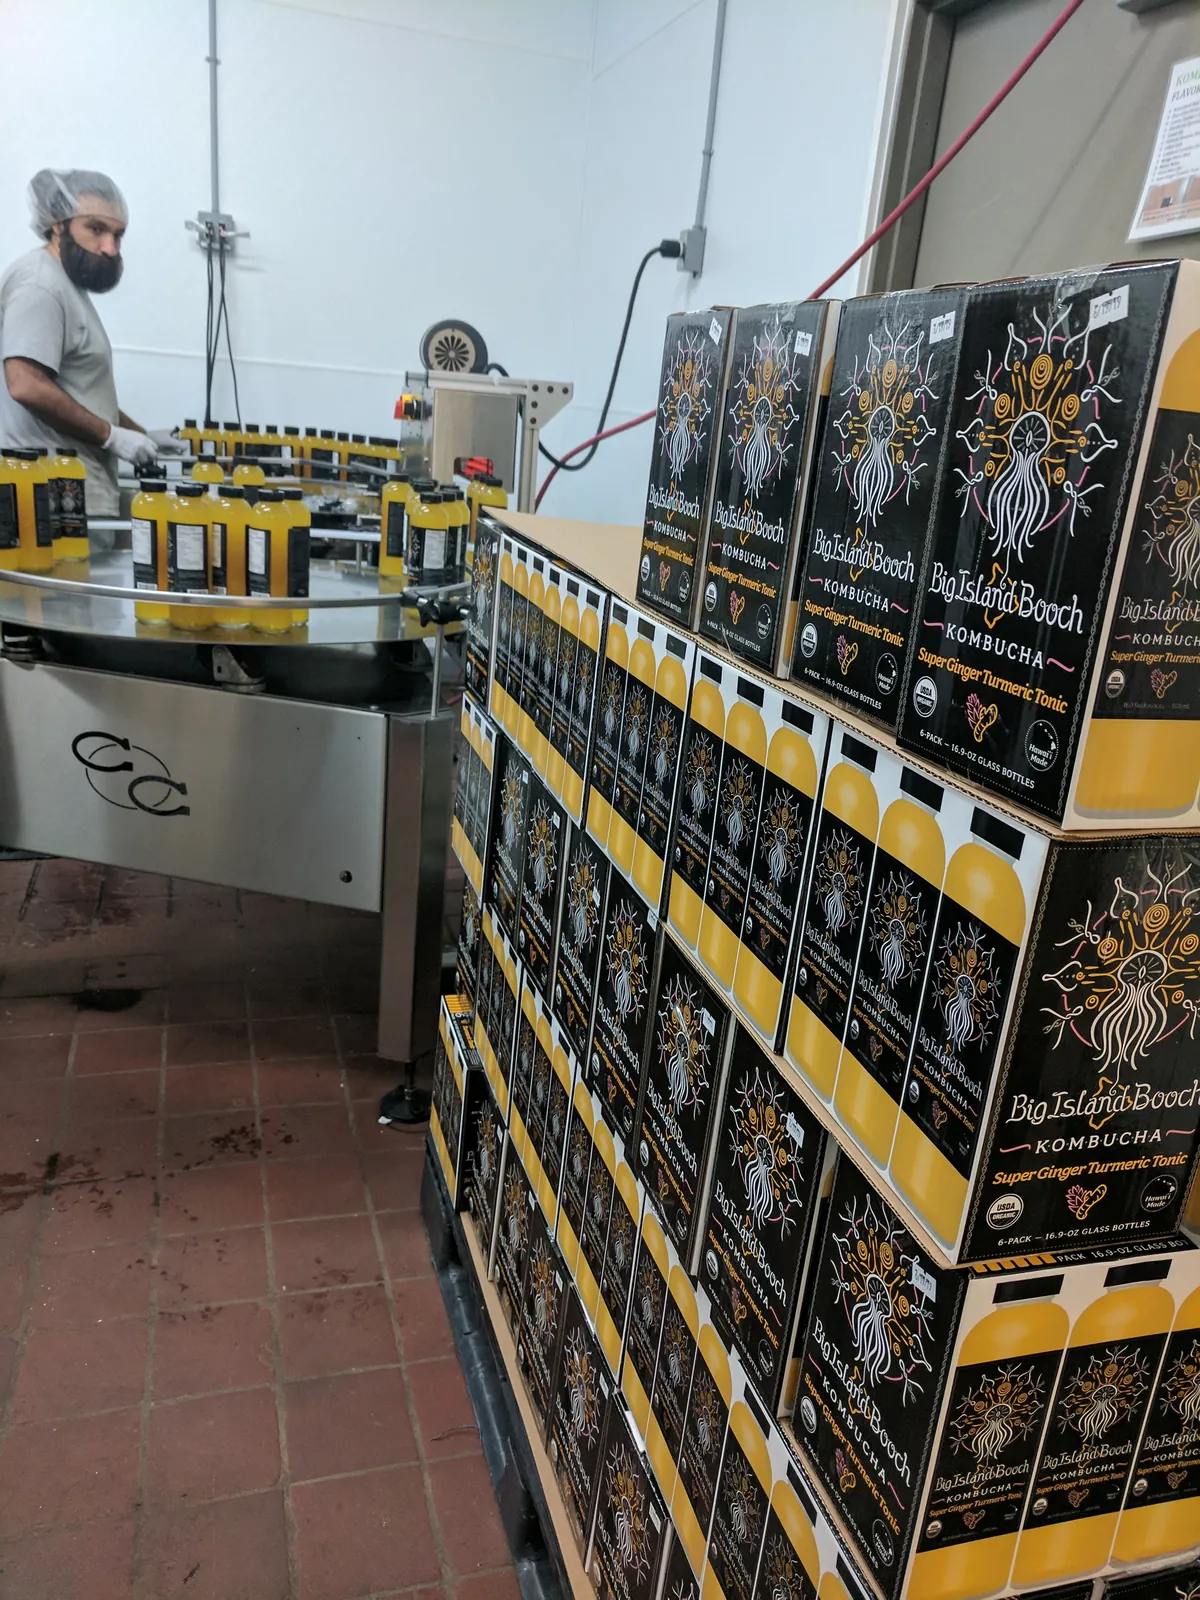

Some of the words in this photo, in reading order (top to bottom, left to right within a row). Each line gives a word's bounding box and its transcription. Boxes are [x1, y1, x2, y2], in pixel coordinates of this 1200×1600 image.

[648, 484, 658, 508] Big
[658, 488, 678, 512] Island
[678, 492, 700, 519] Booch
[654, 520, 686, 543] KOMBUCHA
[714, 501, 726, 530] Big
[726, 506, 755, 534] Island
[754, 510, 784, 544] Booch
[722, 543, 766, 570] KOMBUCHA
[812, 528, 832, 562] Big
[831, 533, 872, 570] Island
[872, 541, 914, 582] Booch
[708, 562, 722, 576] Super
[722, 566, 736, 584] Ginger
[736, 574, 760, 593] Turmeric
[761, 583, 776, 599] Tonic
[824, 578, 889, 613] KOMBUCHA
[928, 561, 956, 603] Big
[955, 568, 1017, 614] Island
[1017, 580, 1083, 635] Booch
[804, 599, 824, 618] Super
[824, 607, 848, 626] Ginger
[848, 616, 882, 640] Turmeric
[882, 628, 904, 648] Tonic
[1119, 596, 1141, 623] Big
[1140, 598, 1190, 622] Island
[946, 622, 1044, 670] KOMBUCHA
[1111, 650, 1134, 663] Super
[1134, 652, 1164, 665] Ginger
[918, 647, 948, 668] Super
[946, 656, 982, 682] Ginger
[982, 669, 1034, 701] Turmeric
[1033, 687, 1069, 714] Tonic
[859, 693, 882, 710] BOTTLES
[920, 729, 943, 746] 6-PACK
[950, 744, 977, 763] 16.9-OZ
[978, 756, 1000, 773] GLASS
[1001, 766, 1035, 790] BOTTLES
[1030, 754, 1048, 768] Made
[755, 898, 783, 930] KOMBUCHA
[806, 920, 818, 941] Big
[814, 929, 835, 956] Island
[834, 946, 852, 976] Booch
[810, 950, 842, 984] KOMBUCHA
[858, 970, 873, 994] Big
[866, 977, 892, 1010] Island
[890, 998, 912, 1033] Booch
[862, 1000, 900, 1040] KOMBUCHA
[602, 1032, 630, 1082] KOMBUCHA
[918, 1026, 933, 1052] Big
[929, 1036, 958, 1076] Island
[956, 1060, 982, 1101] Booch
[912, 1064, 924, 1081] Super
[924, 1076, 941, 1098] Ginger
[940, 1090, 964, 1122] Turmeric
[962, 1116, 976, 1133] Tonic
[924, 1060, 968, 1110] KOMBUCHA
[1006, 1093, 1047, 1124] Big
[1047, 1085, 1130, 1120] Island
[647, 1077, 658, 1109] Big
[656, 1092, 678, 1140] Island
[676, 1124, 698, 1178] Booch
[1035, 1128, 1162, 1154] KOMBUCHA
[652, 1119, 684, 1183] KOMBUCHA
[992, 1170, 1038, 1187] Super
[1037, 1164, 1088, 1181] Ginger
[1088, 1156, 1152, 1174] Turmeric
[1153, 1151, 1188, 1168] Tonic
[996, 1202, 1016, 1212] USDA
[1146, 1200, 1166, 1210] Made
[715, 1180, 729, 1215] Big
[728, 1200, 758, 1258] Island
[758, 1241, 786, 1307] Booch
[998, 1235, 1033, 1247] 6-PACK
[1044, 1228, 1080, 1240] 16.9-OZ
[1081, 1224, 1110, 1236] GLASS
[1112, 1220, 1151, 1232] BOTTLES
[1056, 1252, 1087, 1262] PACK
[1090, 1246, 1133, 1259] 16.9-OZ
[1133, 1242, 1168, 1253] GLASS
[723, 1228, 770, 1310] KOMBUCHA
[708, 1229, 724, 1252] Super
[723, 1252, 741, 1282] Ginger
[740, 1280, 764, 1327] Turmeric
[763, 1322, 779, 1350] Tonic
[812, 1316, 831, 1361] Big
[828, 1342, 870, 1418] Island
[870, 1401, 911, 1488] Booch
[822, 1376, 886, 1486] KOMBUCHA
[1143, 1436, 1160, 1452] Big
[1158, 1428, 1198, 1448] Island
[804, 1373, 824, 1406] Super
[822, 1402, 846, 1444] Ginger
[844, 1440, 880, 1501] Turmeric
[879, 1498, 900, 1536] Tonic
[1042, 1455, 1059, 1470] Big
[1058, 1446, 1099, 1466] Island
[1099, 1440, 1133, 1459] Booch
[1052, 1463, 1115, 1482] KOMBUCHA
[934, 1477, 952, 1492] Big
[950, 1470, 996, 1488] Island
[995, 1460, 1030, 1478] Booch
[946, 1483, 1012, 1504] KOMBUCHA
